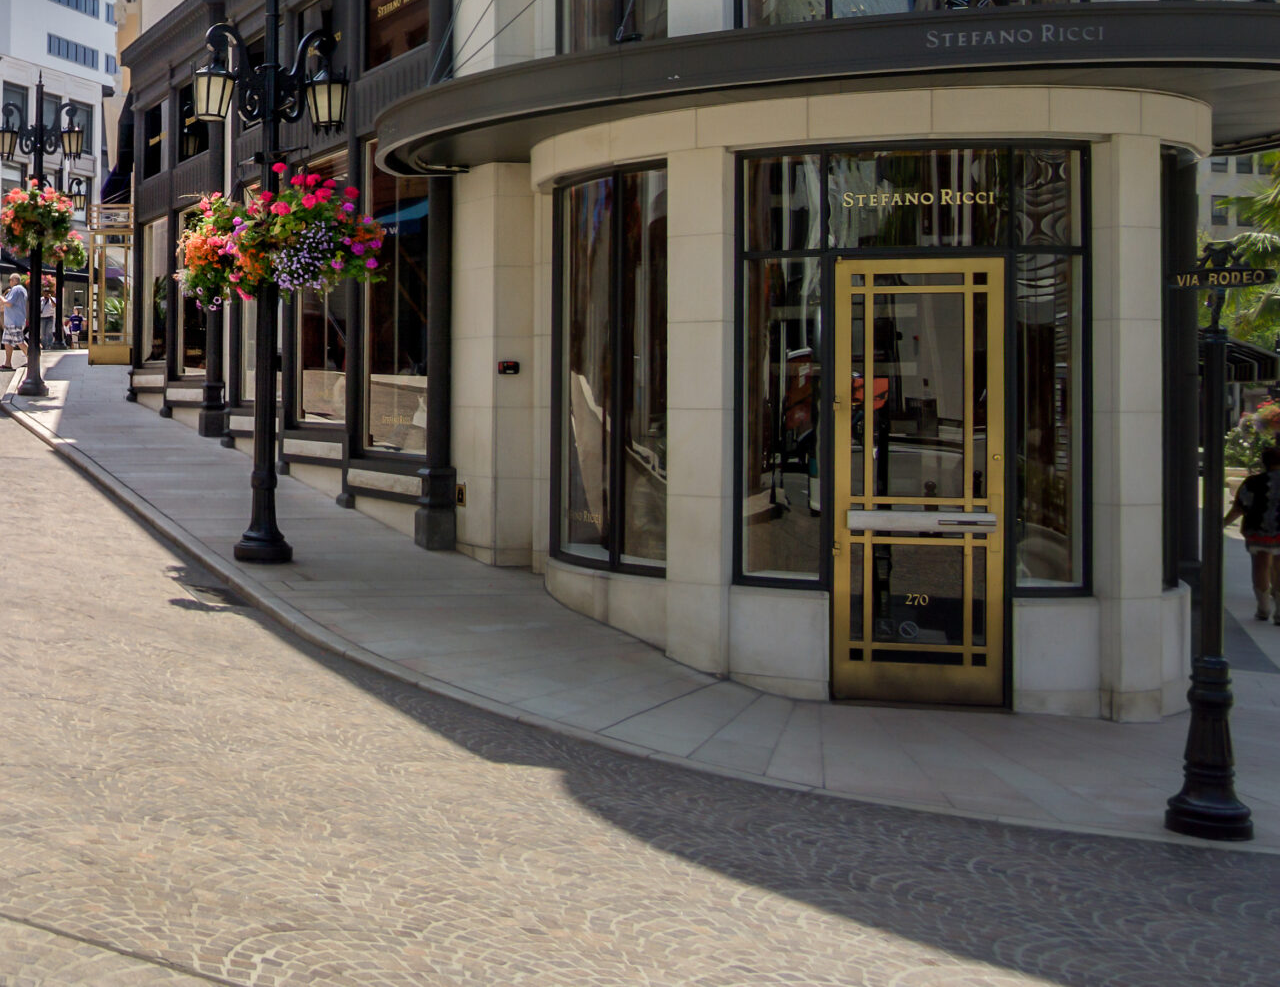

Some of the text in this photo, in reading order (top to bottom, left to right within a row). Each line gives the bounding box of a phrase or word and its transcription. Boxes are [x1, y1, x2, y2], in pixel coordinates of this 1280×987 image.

[926, 23, 1104, 48] STEFANO RICCI
[842, 188, 995, 208] STEFANO RICCI
[1177, 269, 1265, 287] VIA RODEO
[905, 593, 929, 606] 270
